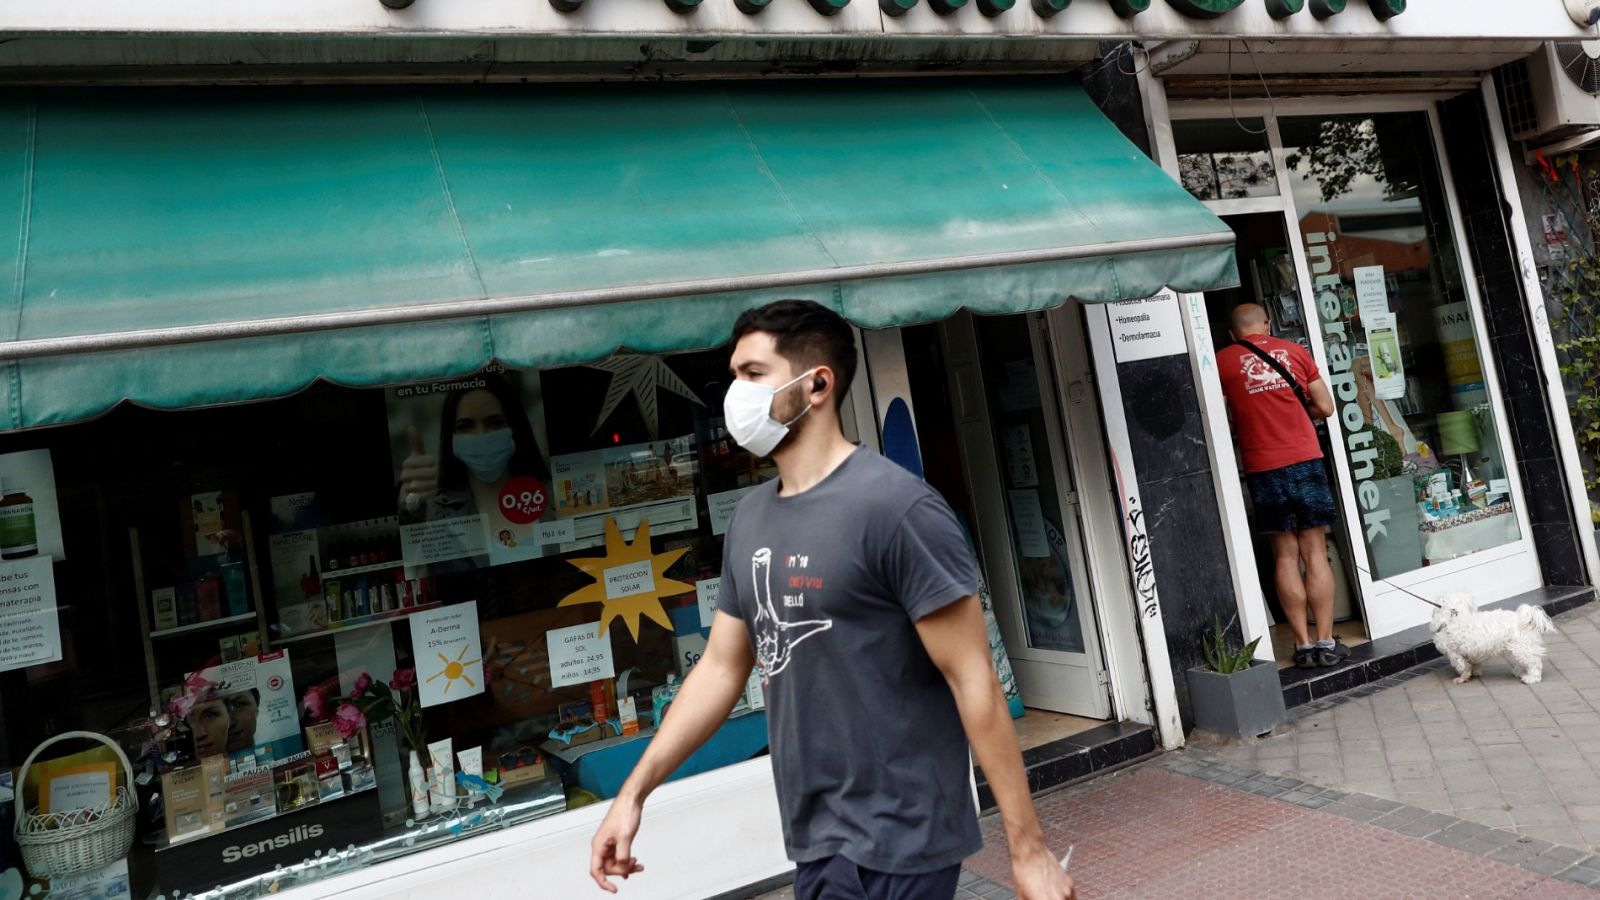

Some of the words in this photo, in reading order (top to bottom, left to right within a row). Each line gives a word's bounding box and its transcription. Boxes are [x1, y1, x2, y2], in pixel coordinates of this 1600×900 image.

[1122, 330, 1161, 343] Dermofarmacia
[398, 389, 413, 398] en
[416, 386, 429, 395] tu
[432, 378, 486, 393] Farmacia
[1306, 231, 1390, 544] interapothek
[502, 489, 545, 510] 0,96
[15, 572, 29, 581] tus
[609, 570, 648, 584] PROTECCION
[24, 583, 39, 592] con
[620, 583, 641, 594] SOLAR
[431, 624, 461, 635] A-Derma
[564, 634, 585, 644] GAFAS
[587, 631, 596, 640] DE
[222, 823, 325, 864] Sensilis
